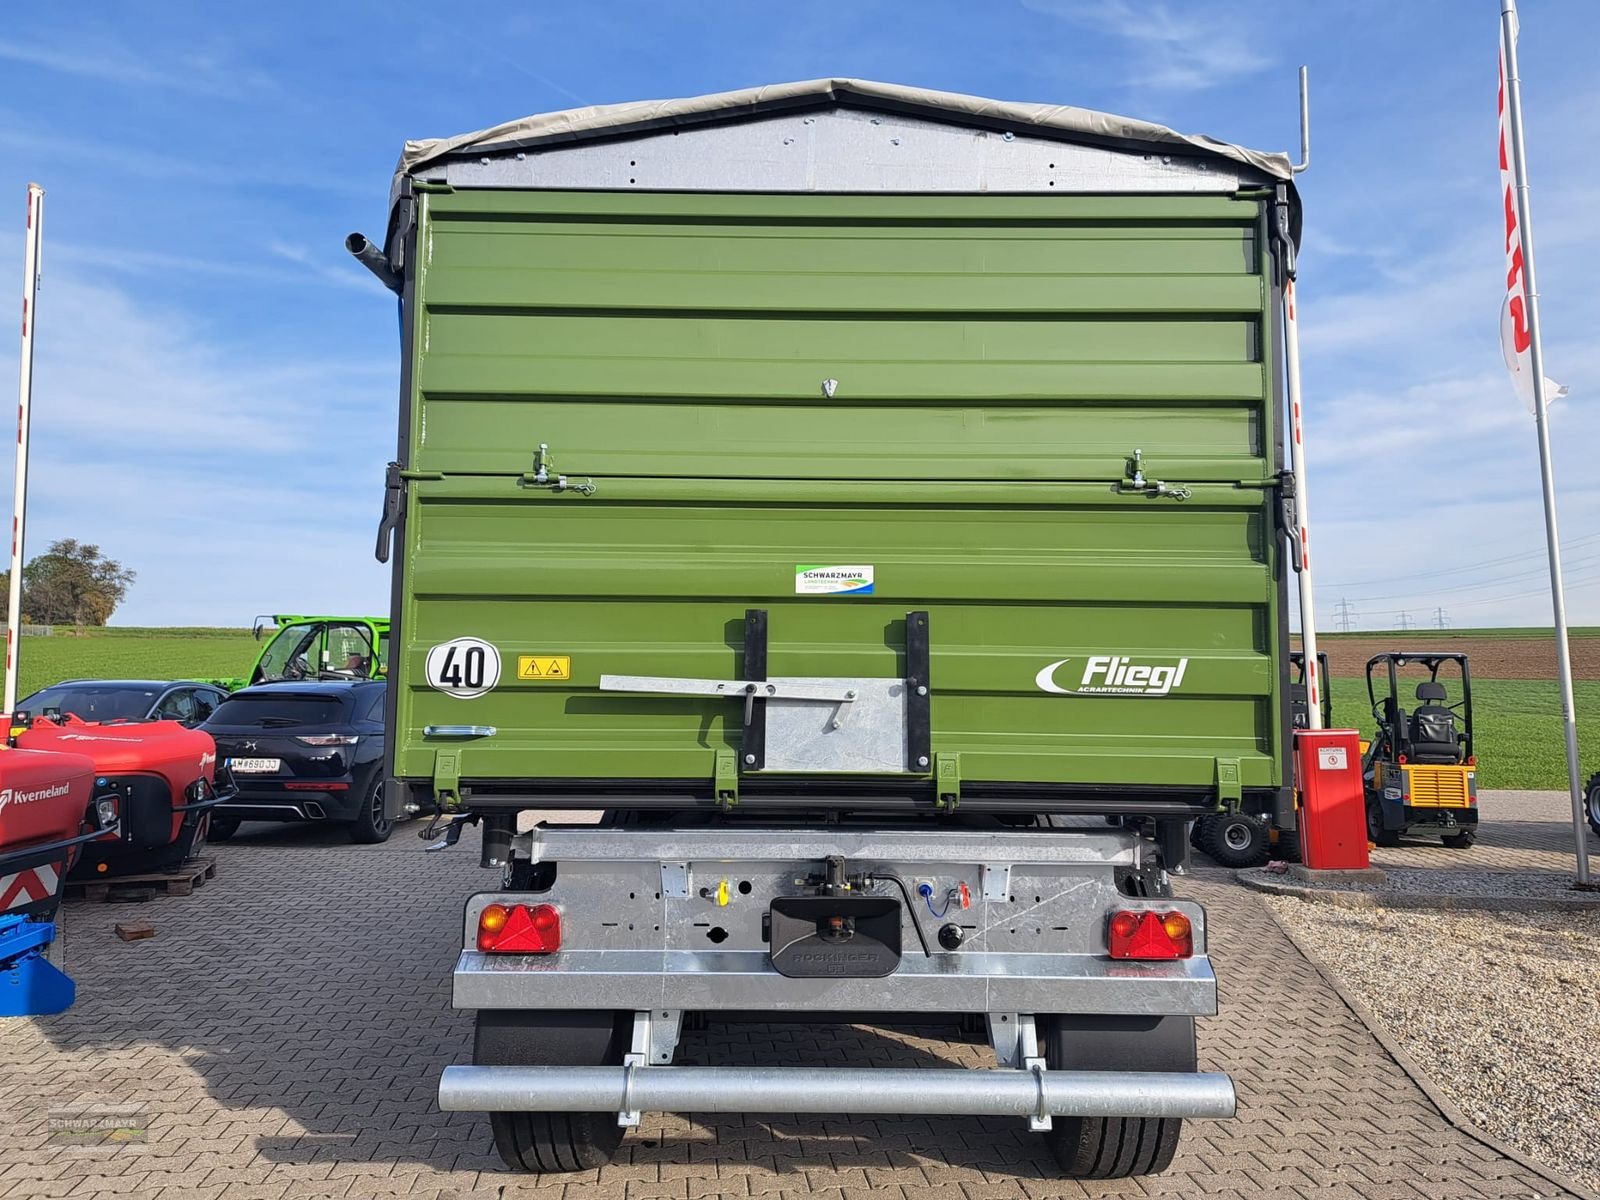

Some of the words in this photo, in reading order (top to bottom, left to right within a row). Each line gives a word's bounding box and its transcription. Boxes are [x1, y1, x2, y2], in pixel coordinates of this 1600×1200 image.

[440, 646, 485, 688] 40
[1081, 656, 1188, 694] Fliegl
[1077, 686, 1145, 694] AGRARTECHNIK
[14, 782, 69, 804] Kverneland
